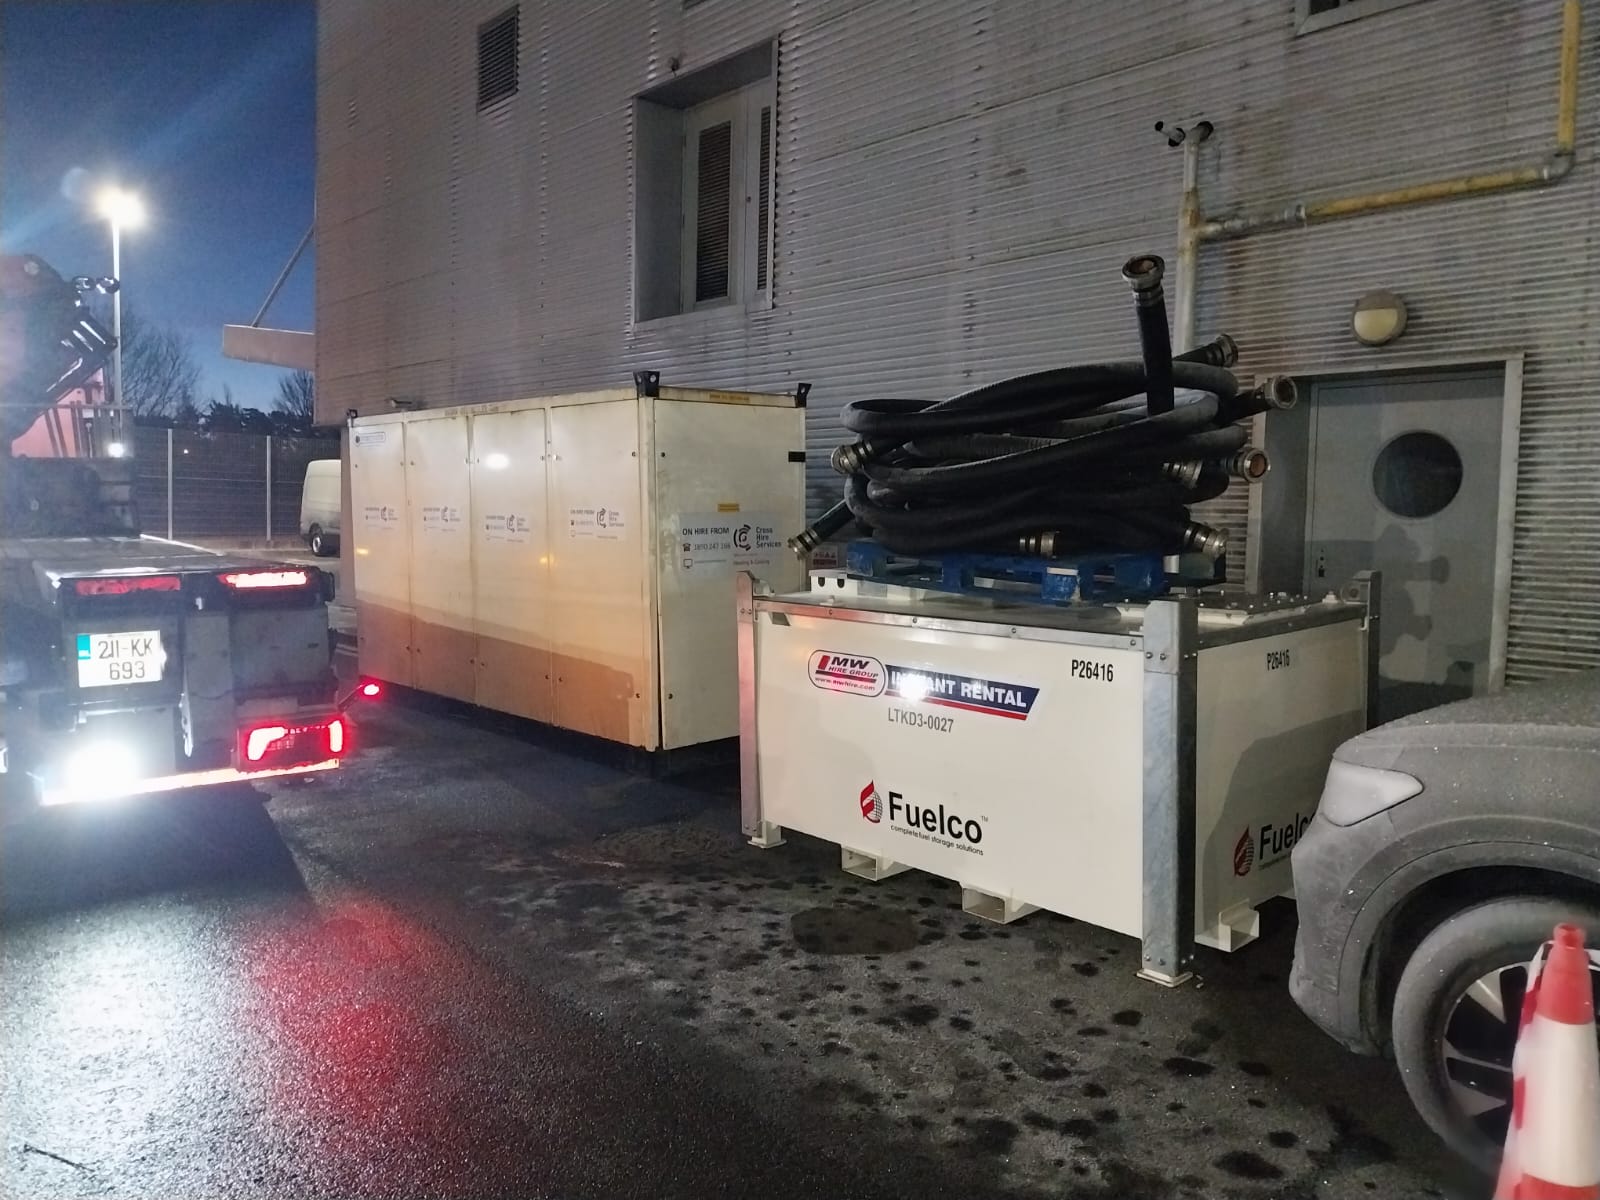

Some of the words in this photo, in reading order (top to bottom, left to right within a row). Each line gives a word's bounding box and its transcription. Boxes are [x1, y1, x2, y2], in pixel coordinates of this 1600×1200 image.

[682, 528, 693, 536] ON
[694, 527, 709, 535] HIRE
[710, 527, 730, 535] FROM
[755, 526, 773, 534] Cross
[109, 660, 145, 681] 693
[1071, 659, 1114, 682] P26416
[1266, 649, 1290, 671] P26416
[828, 666, 848, 674] HIRE
[850, 669, 879, 678] GROUP
[961, 681, 1027, 708] RENTAL
[888, 707, 954, 733] LTKD3-0027
[889, 791, 982, 843] Fuelco
[931, 836, 954, 849] storage
[956, 843, 984, 856] solutions
